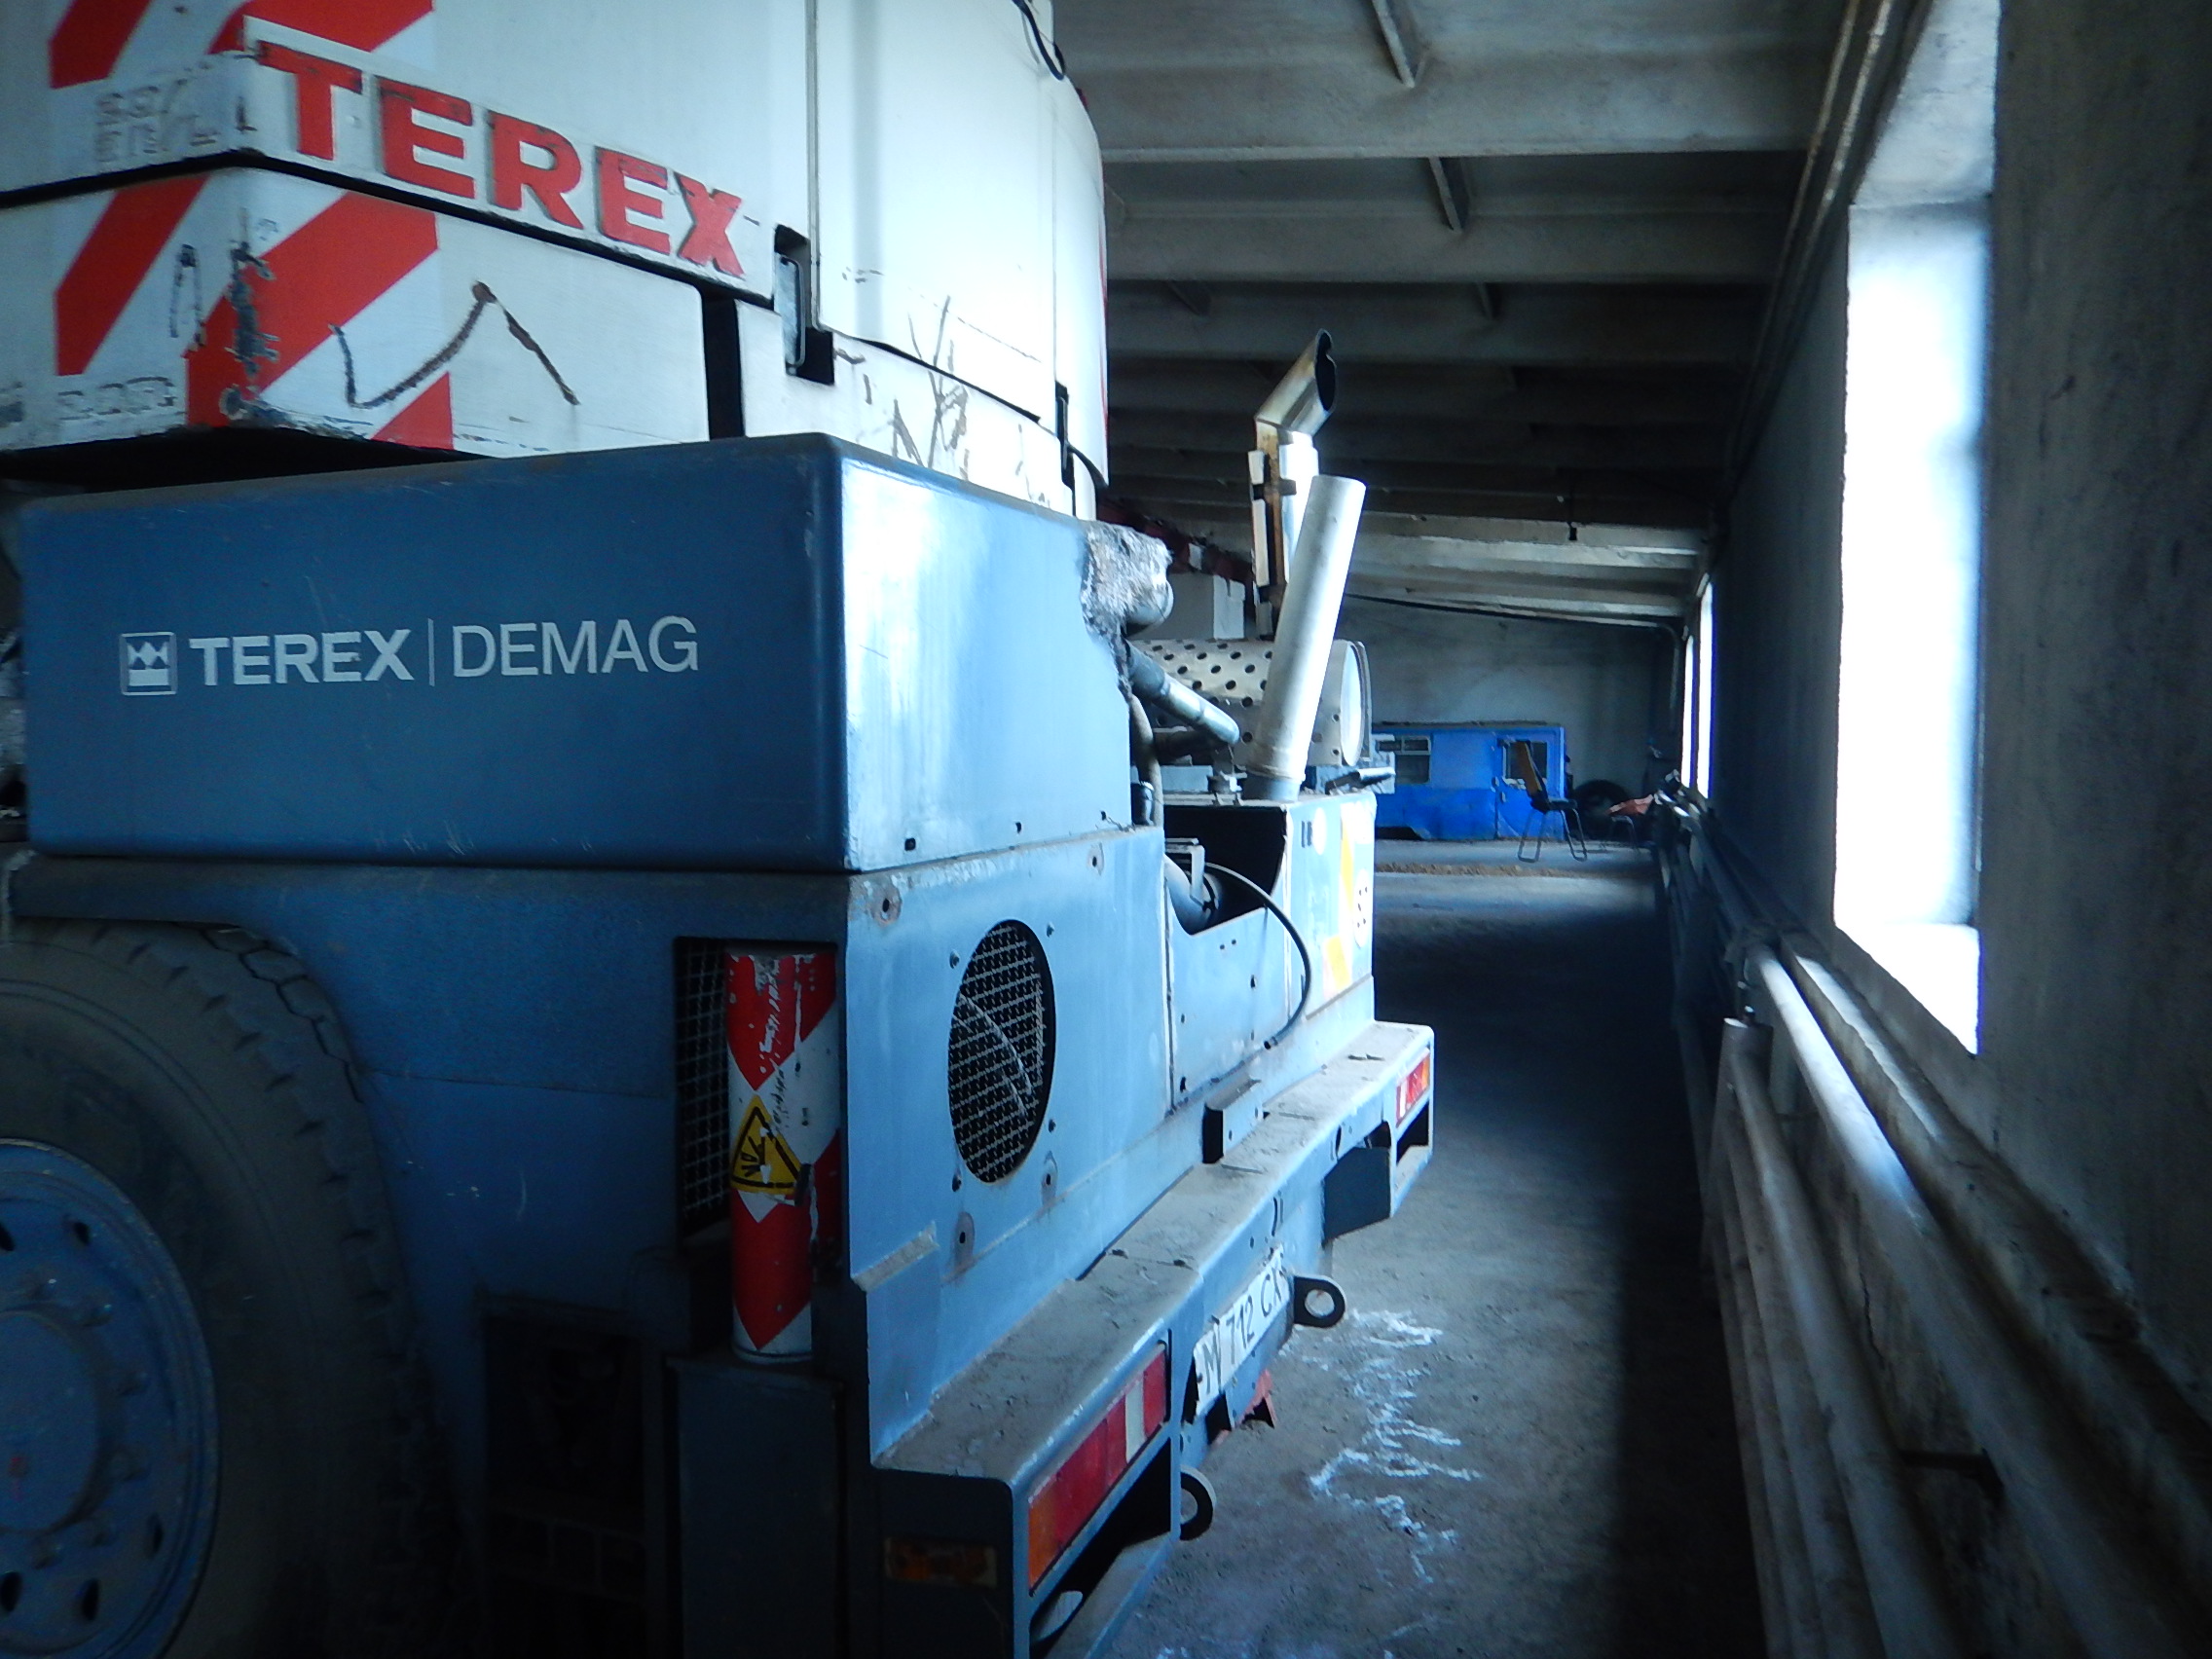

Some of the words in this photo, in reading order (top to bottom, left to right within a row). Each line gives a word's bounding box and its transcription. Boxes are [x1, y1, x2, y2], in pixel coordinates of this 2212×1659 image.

[255, 41, 746, 277] TEREX
[189, 629, 415, 686] TEREX
[453, 614, 700, 679] DEMAG
[1226, 1294, 1254, 1365] 712
